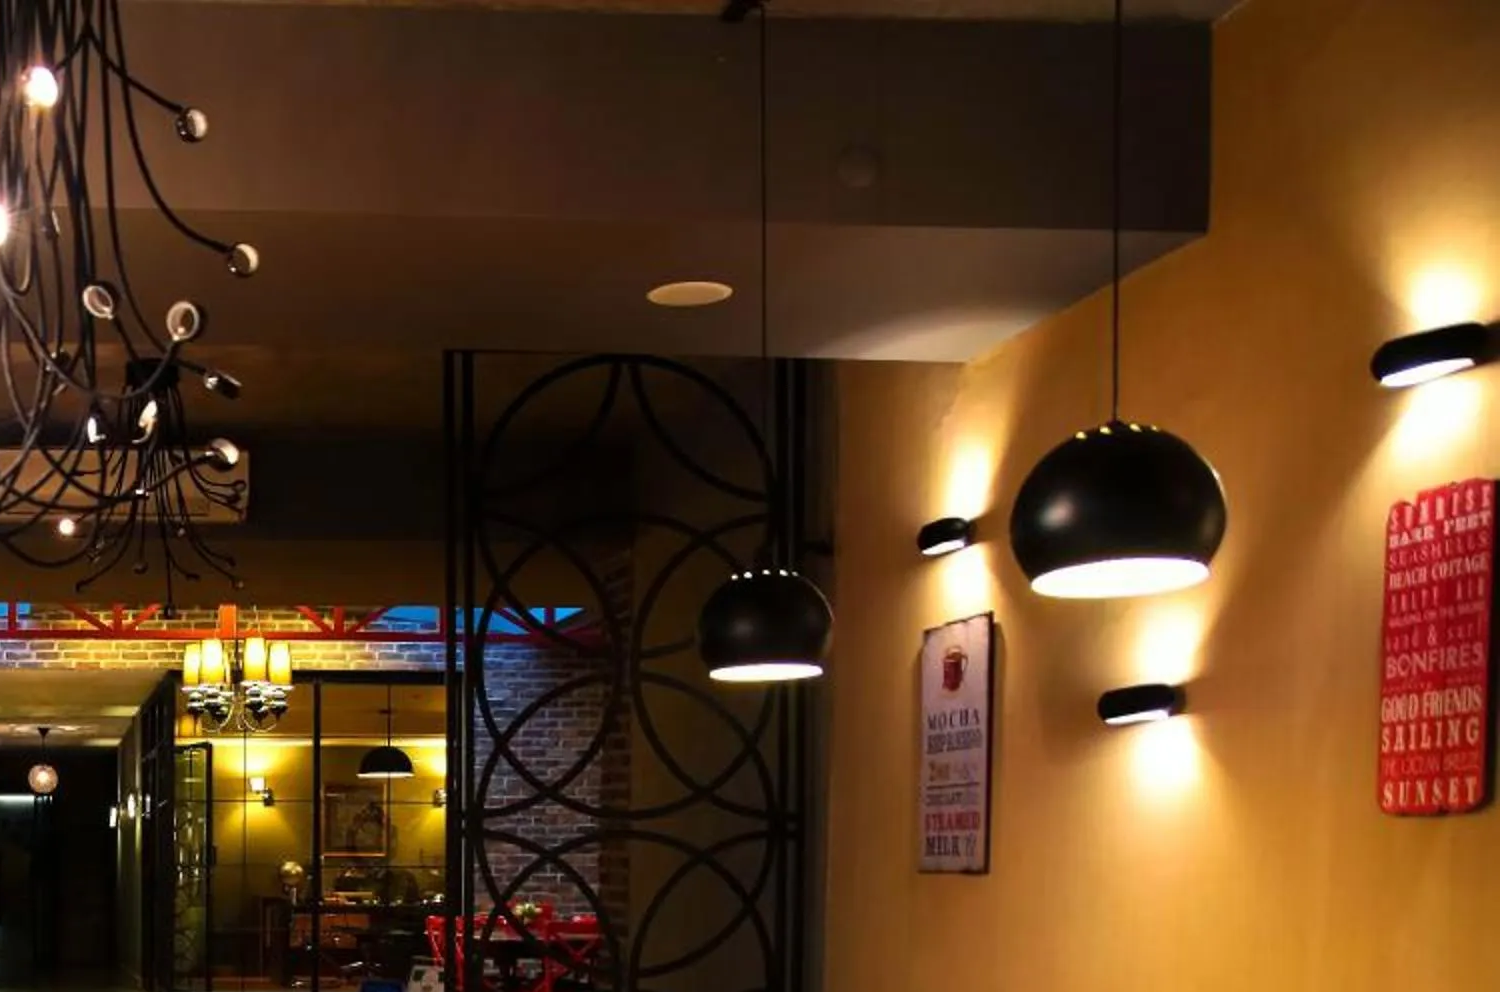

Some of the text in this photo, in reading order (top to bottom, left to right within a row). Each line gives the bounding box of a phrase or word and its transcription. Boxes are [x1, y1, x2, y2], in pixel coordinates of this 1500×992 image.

[1391, 484, 1491, 534] SUNRISE
[1389, 509, 1491, 550] BARE FEET
[1389, 529, 1488, 571] SEASHELLS
[1390, 551, 1488, 591] BEACH COTTAGE
[1427, 623, 1438, 646] &
[1386, 641, 1484, 680] BONFIRES
[927, 708, 980, 731] MOCHA
[1381, 685, 1482, 723] GOOD FRIENDS
[1381, 716, 1480, 753] SAILING
[1382, 777, 1477, 808] SUNSET
[925, 810, 980, 834] STEAMED
[925, 834, 961, 858] MILK
